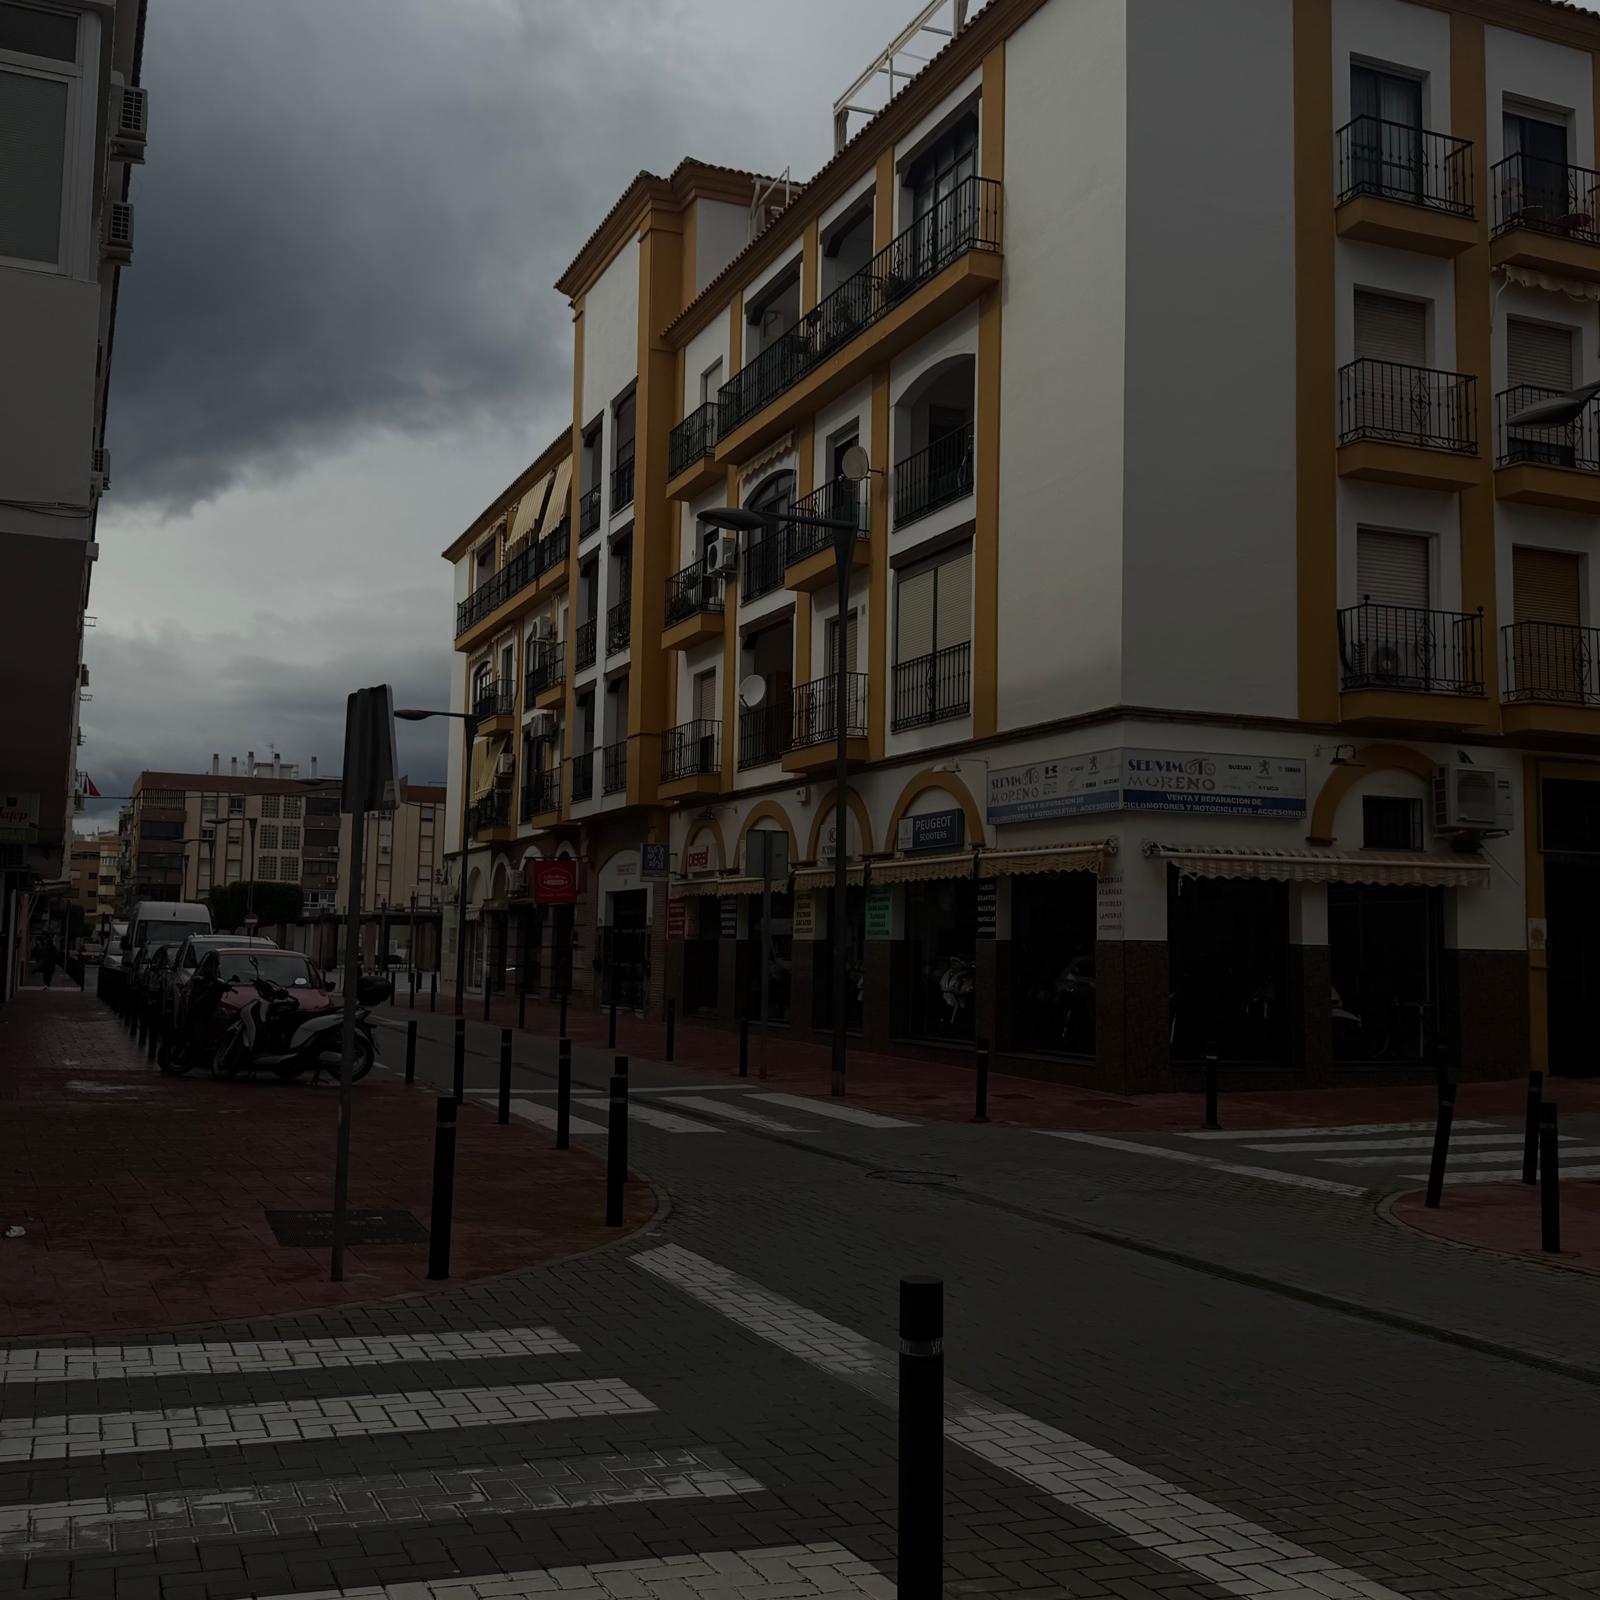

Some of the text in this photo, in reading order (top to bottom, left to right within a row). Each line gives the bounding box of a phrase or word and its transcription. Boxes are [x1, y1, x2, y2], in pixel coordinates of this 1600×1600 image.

[1127, 777, 1216, 792] MORENO
[991, 787, 1039, 804] MORENO
[1167, 793, 1194, 802] VENTA
[1252, 798, 1262, 806] DE
[1123, 802, 1185, 811] CICLOMOTORES
[1193, 805, 1252, 815] MOTOCICLETAS
[1258, 808, 1306, 818] ACCESORIOS
[916, 816, 953, 831] PEUGEOT
[920, 831, 948, 841] SCOOTERS
